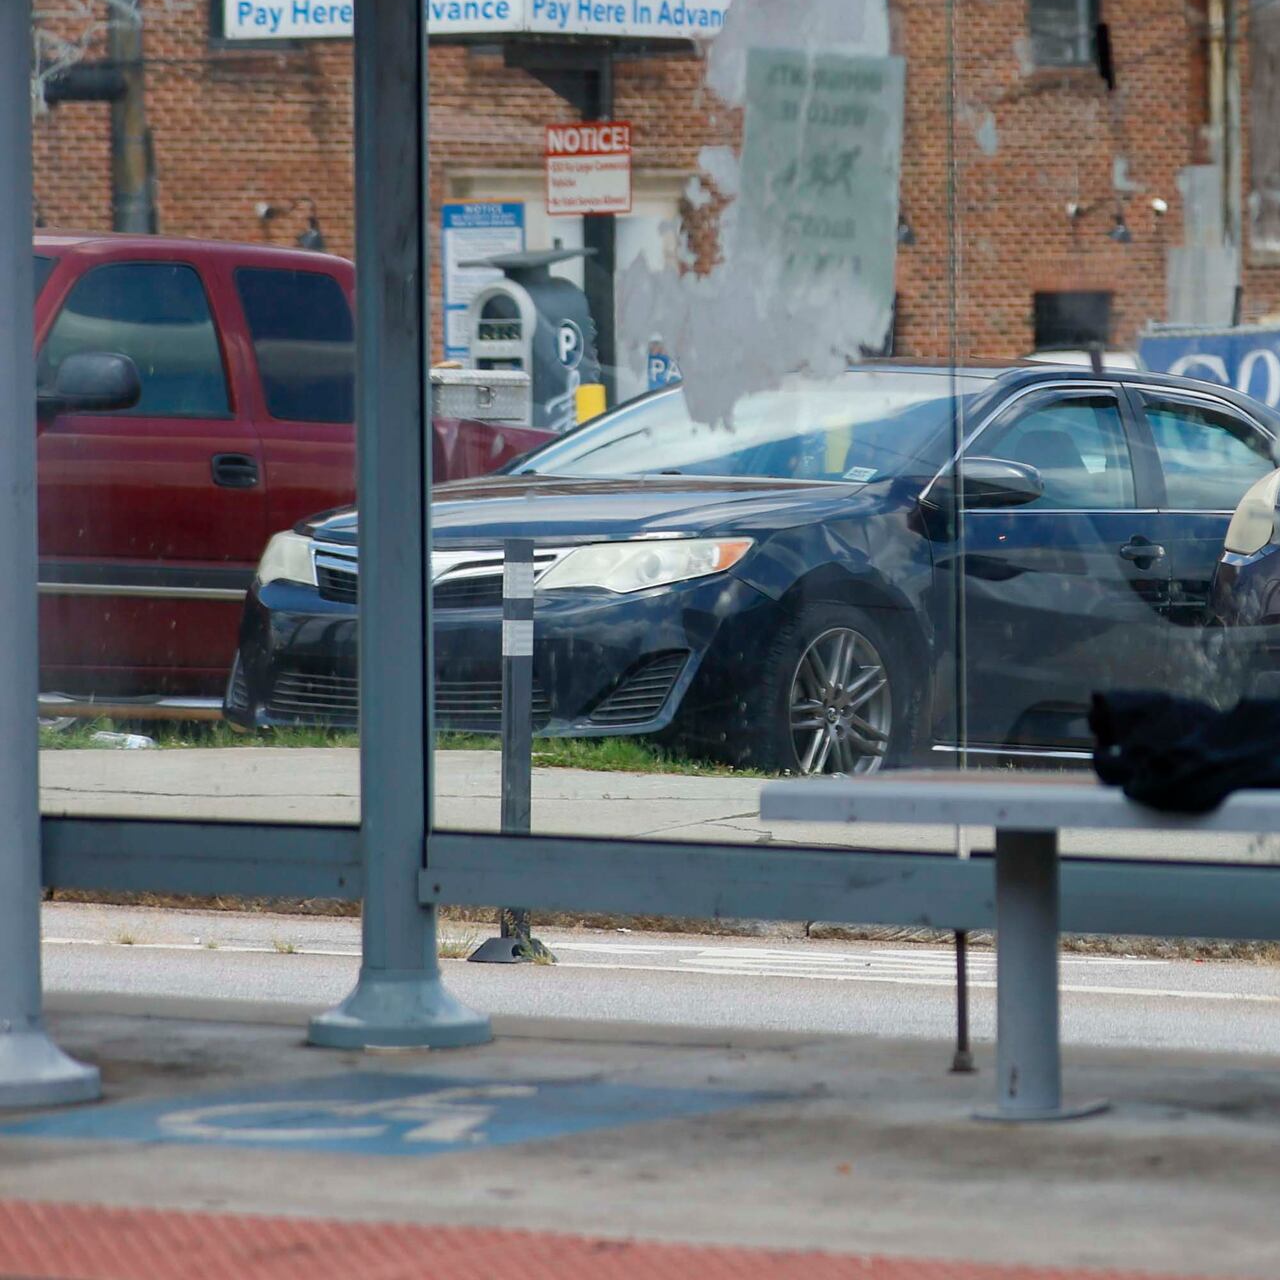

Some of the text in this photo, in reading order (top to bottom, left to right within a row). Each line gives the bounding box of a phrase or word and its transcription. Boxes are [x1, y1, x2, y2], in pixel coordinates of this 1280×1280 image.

[237, 0, 353, 32] Pay Here
[657, 0, 728, 28] Advan
[547, 126, 630, 153] NOTICE!
[558, 326, 577, 362] P
[650, 355, 682, 383] PA
